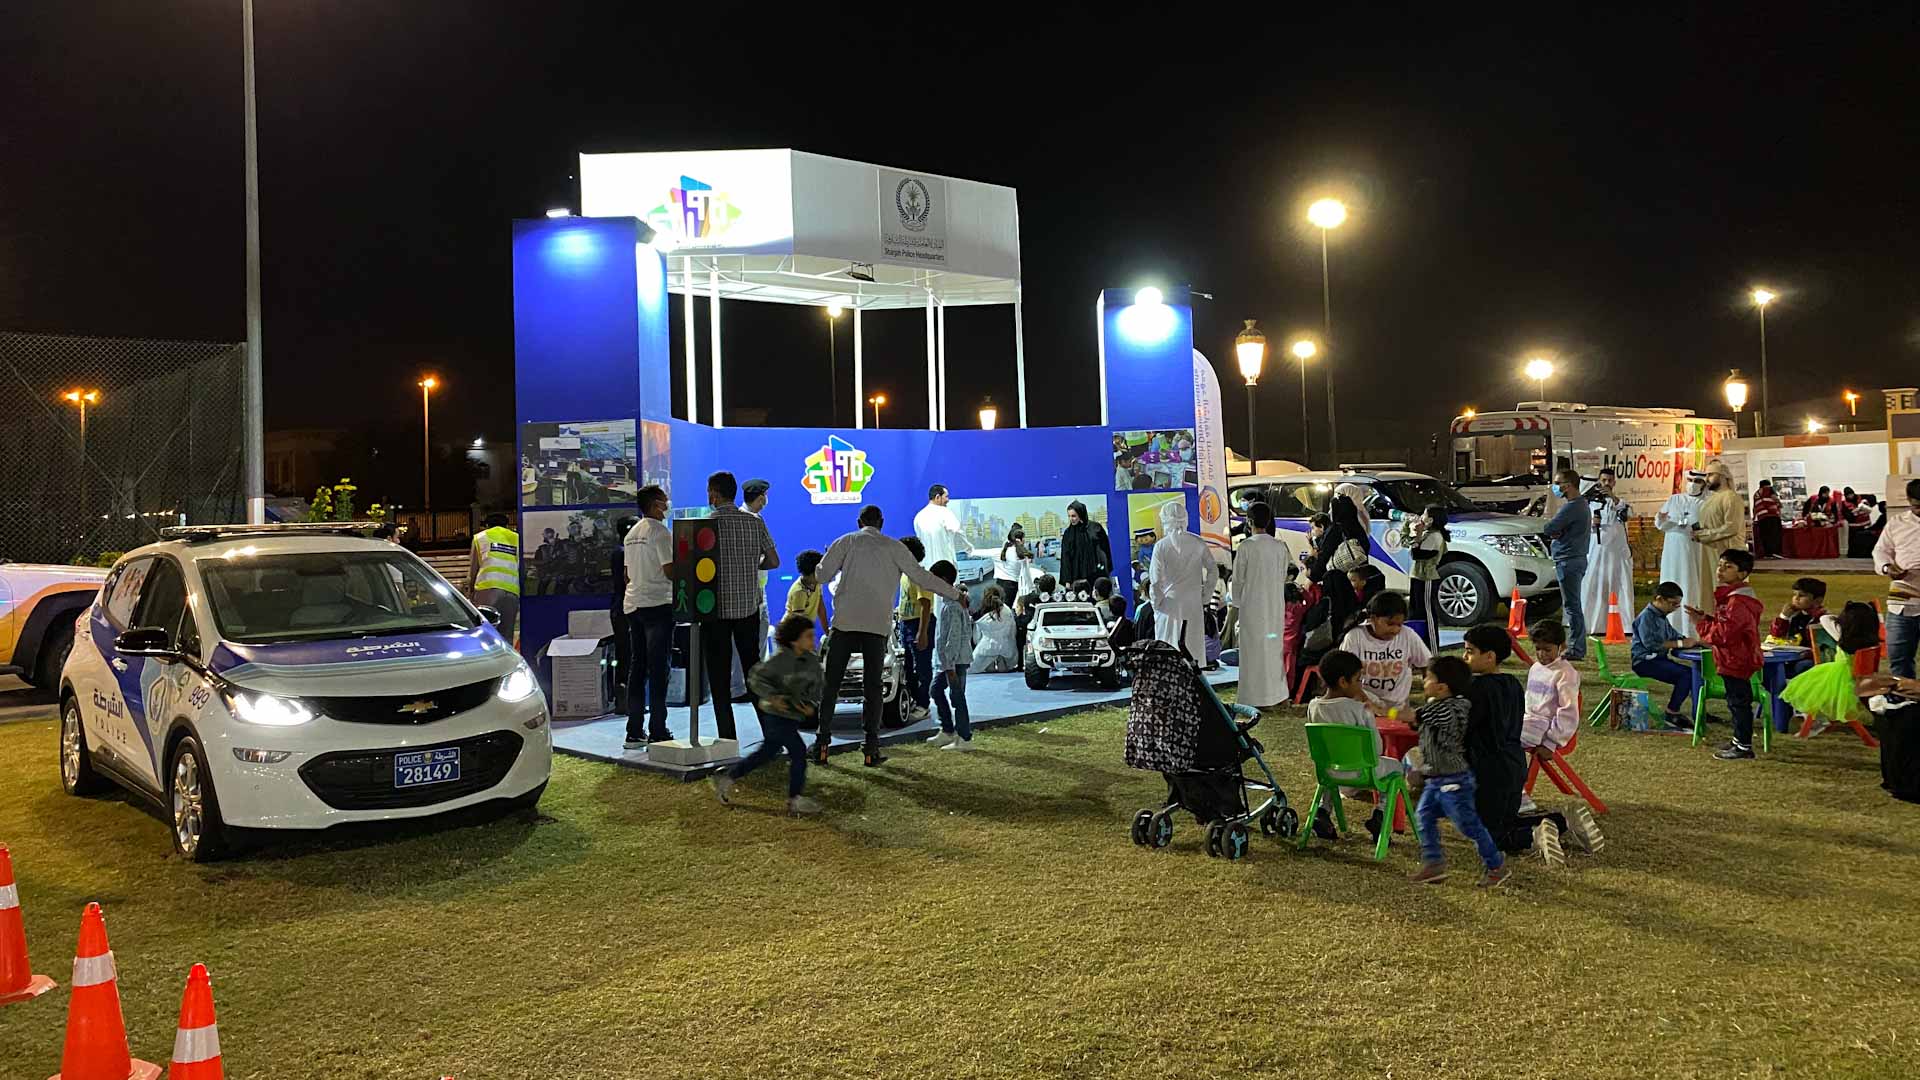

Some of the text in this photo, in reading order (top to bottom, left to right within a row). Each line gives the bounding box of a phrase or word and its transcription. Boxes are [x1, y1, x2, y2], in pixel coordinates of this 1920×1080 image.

[1618, 433, 1647, 450] المتنقل
[1649, 434, 1671, 450] المتجر
[346, 641, 420, 653] الشرطة
[1364, 647, 1403, 660] make
[93, 687, 123, 719] الشرطة
[188, 685, 210, 710] 999
[399, 754, 422, 766] POLICE
[403, 763, 452, 784] 28149
